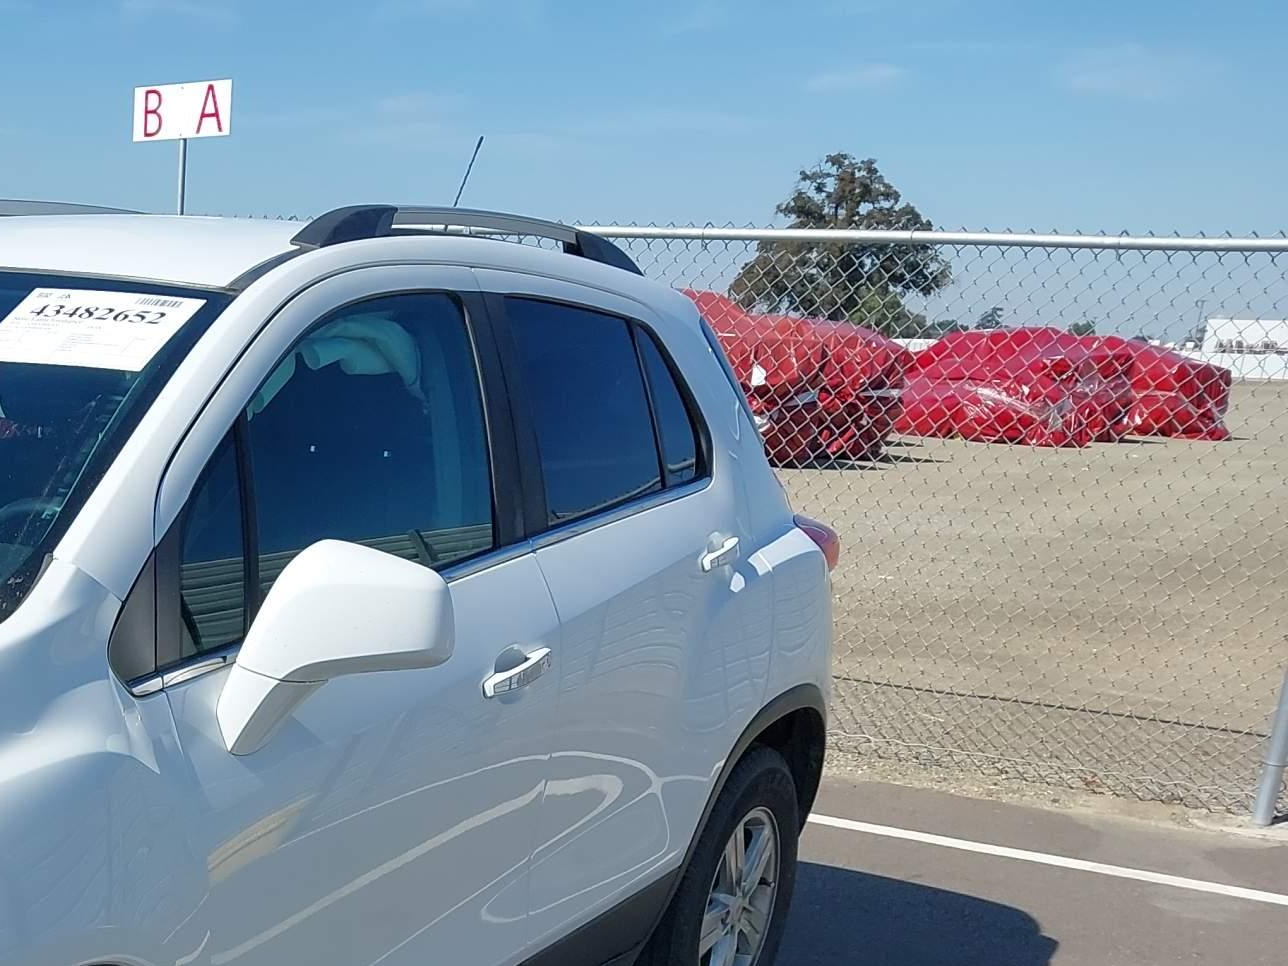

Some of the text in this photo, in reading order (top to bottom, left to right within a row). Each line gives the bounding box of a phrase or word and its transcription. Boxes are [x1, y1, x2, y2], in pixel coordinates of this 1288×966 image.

[143, 83, 223, 138] B A
[29, 303, 168, 325] 43482652
